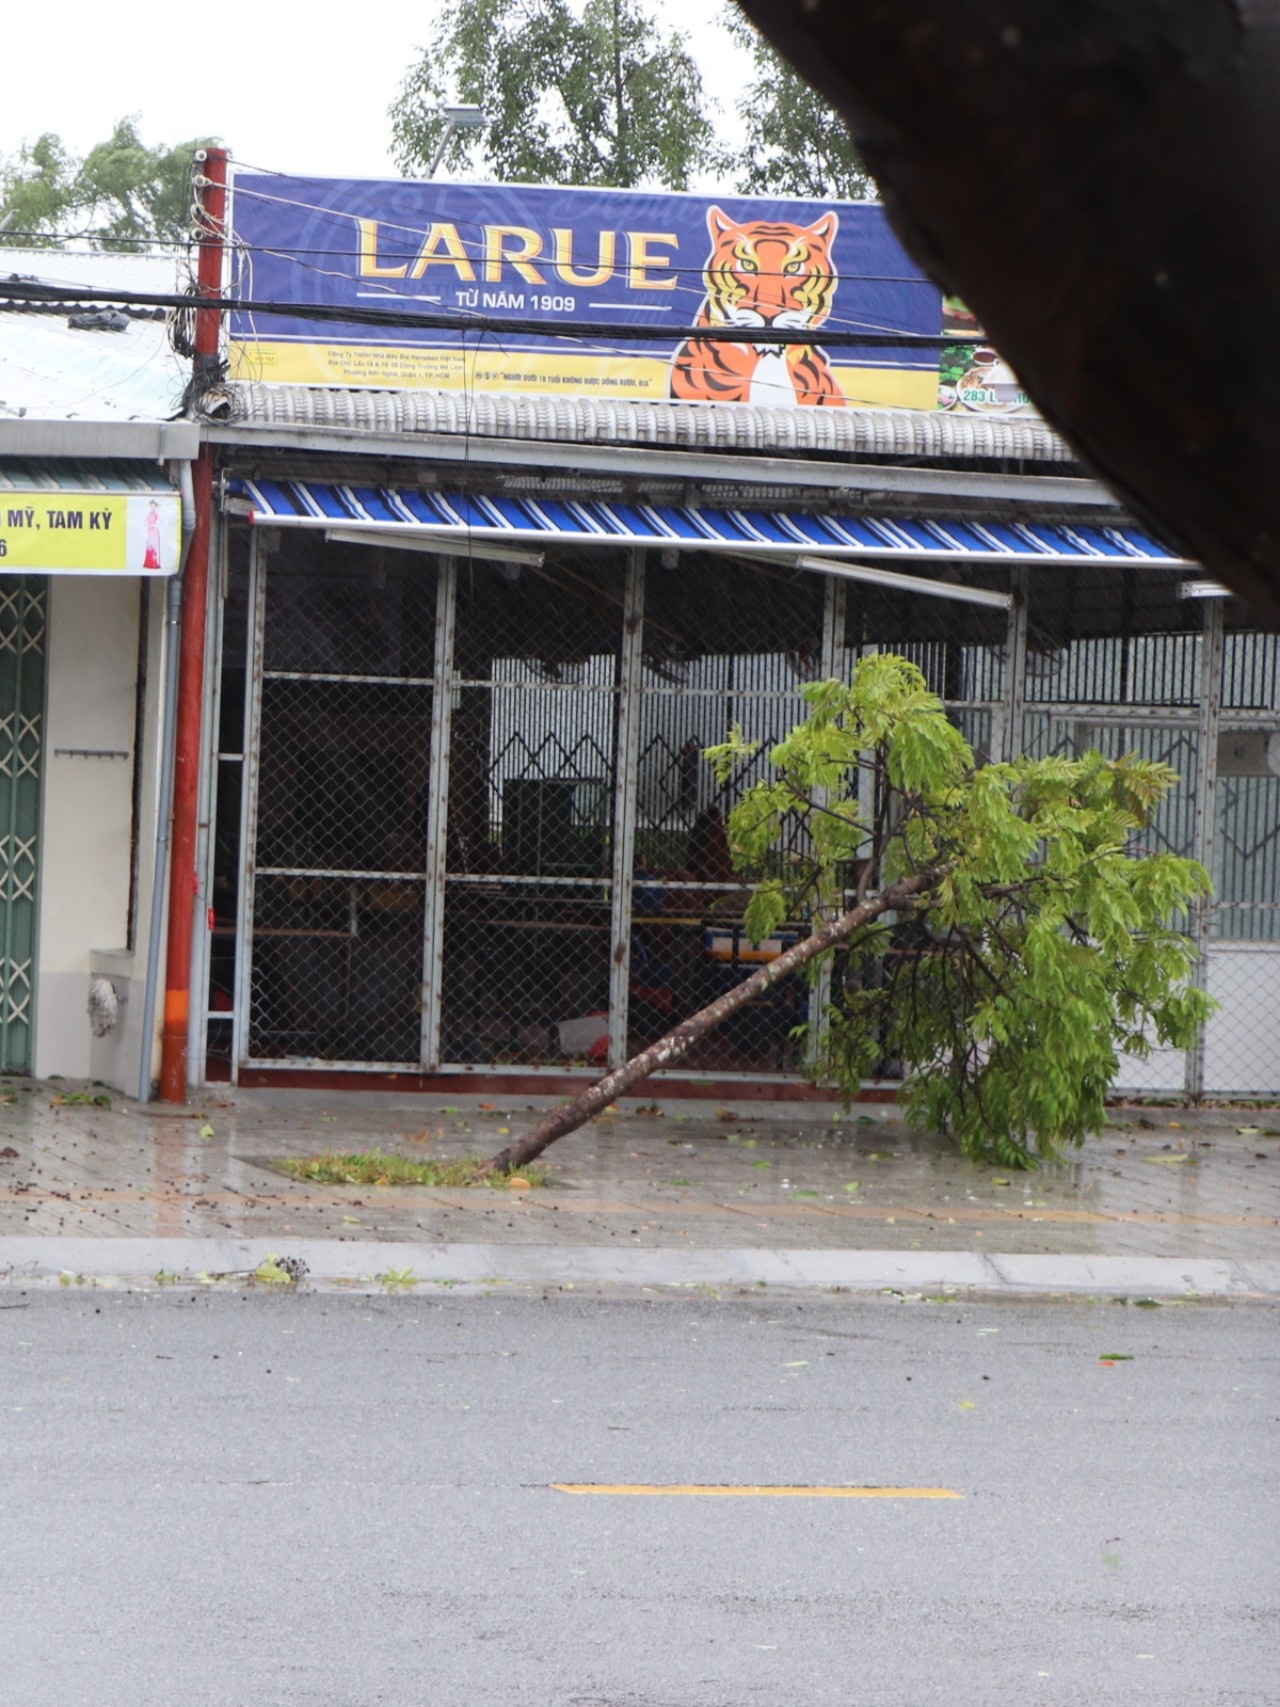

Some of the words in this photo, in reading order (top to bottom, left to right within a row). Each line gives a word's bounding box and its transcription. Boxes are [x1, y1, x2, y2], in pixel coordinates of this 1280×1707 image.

[354, 218, 680, 290] LARUE
[455, 288, 479, 307] TỪ
[482, 292, 525, 310] NĂM
[530, 294, 576, 312] 1909
[963, 389, 986, 401] 283
[7, 506, 41, 531] MỸ,
[46, 509, 84, 530] TAM
